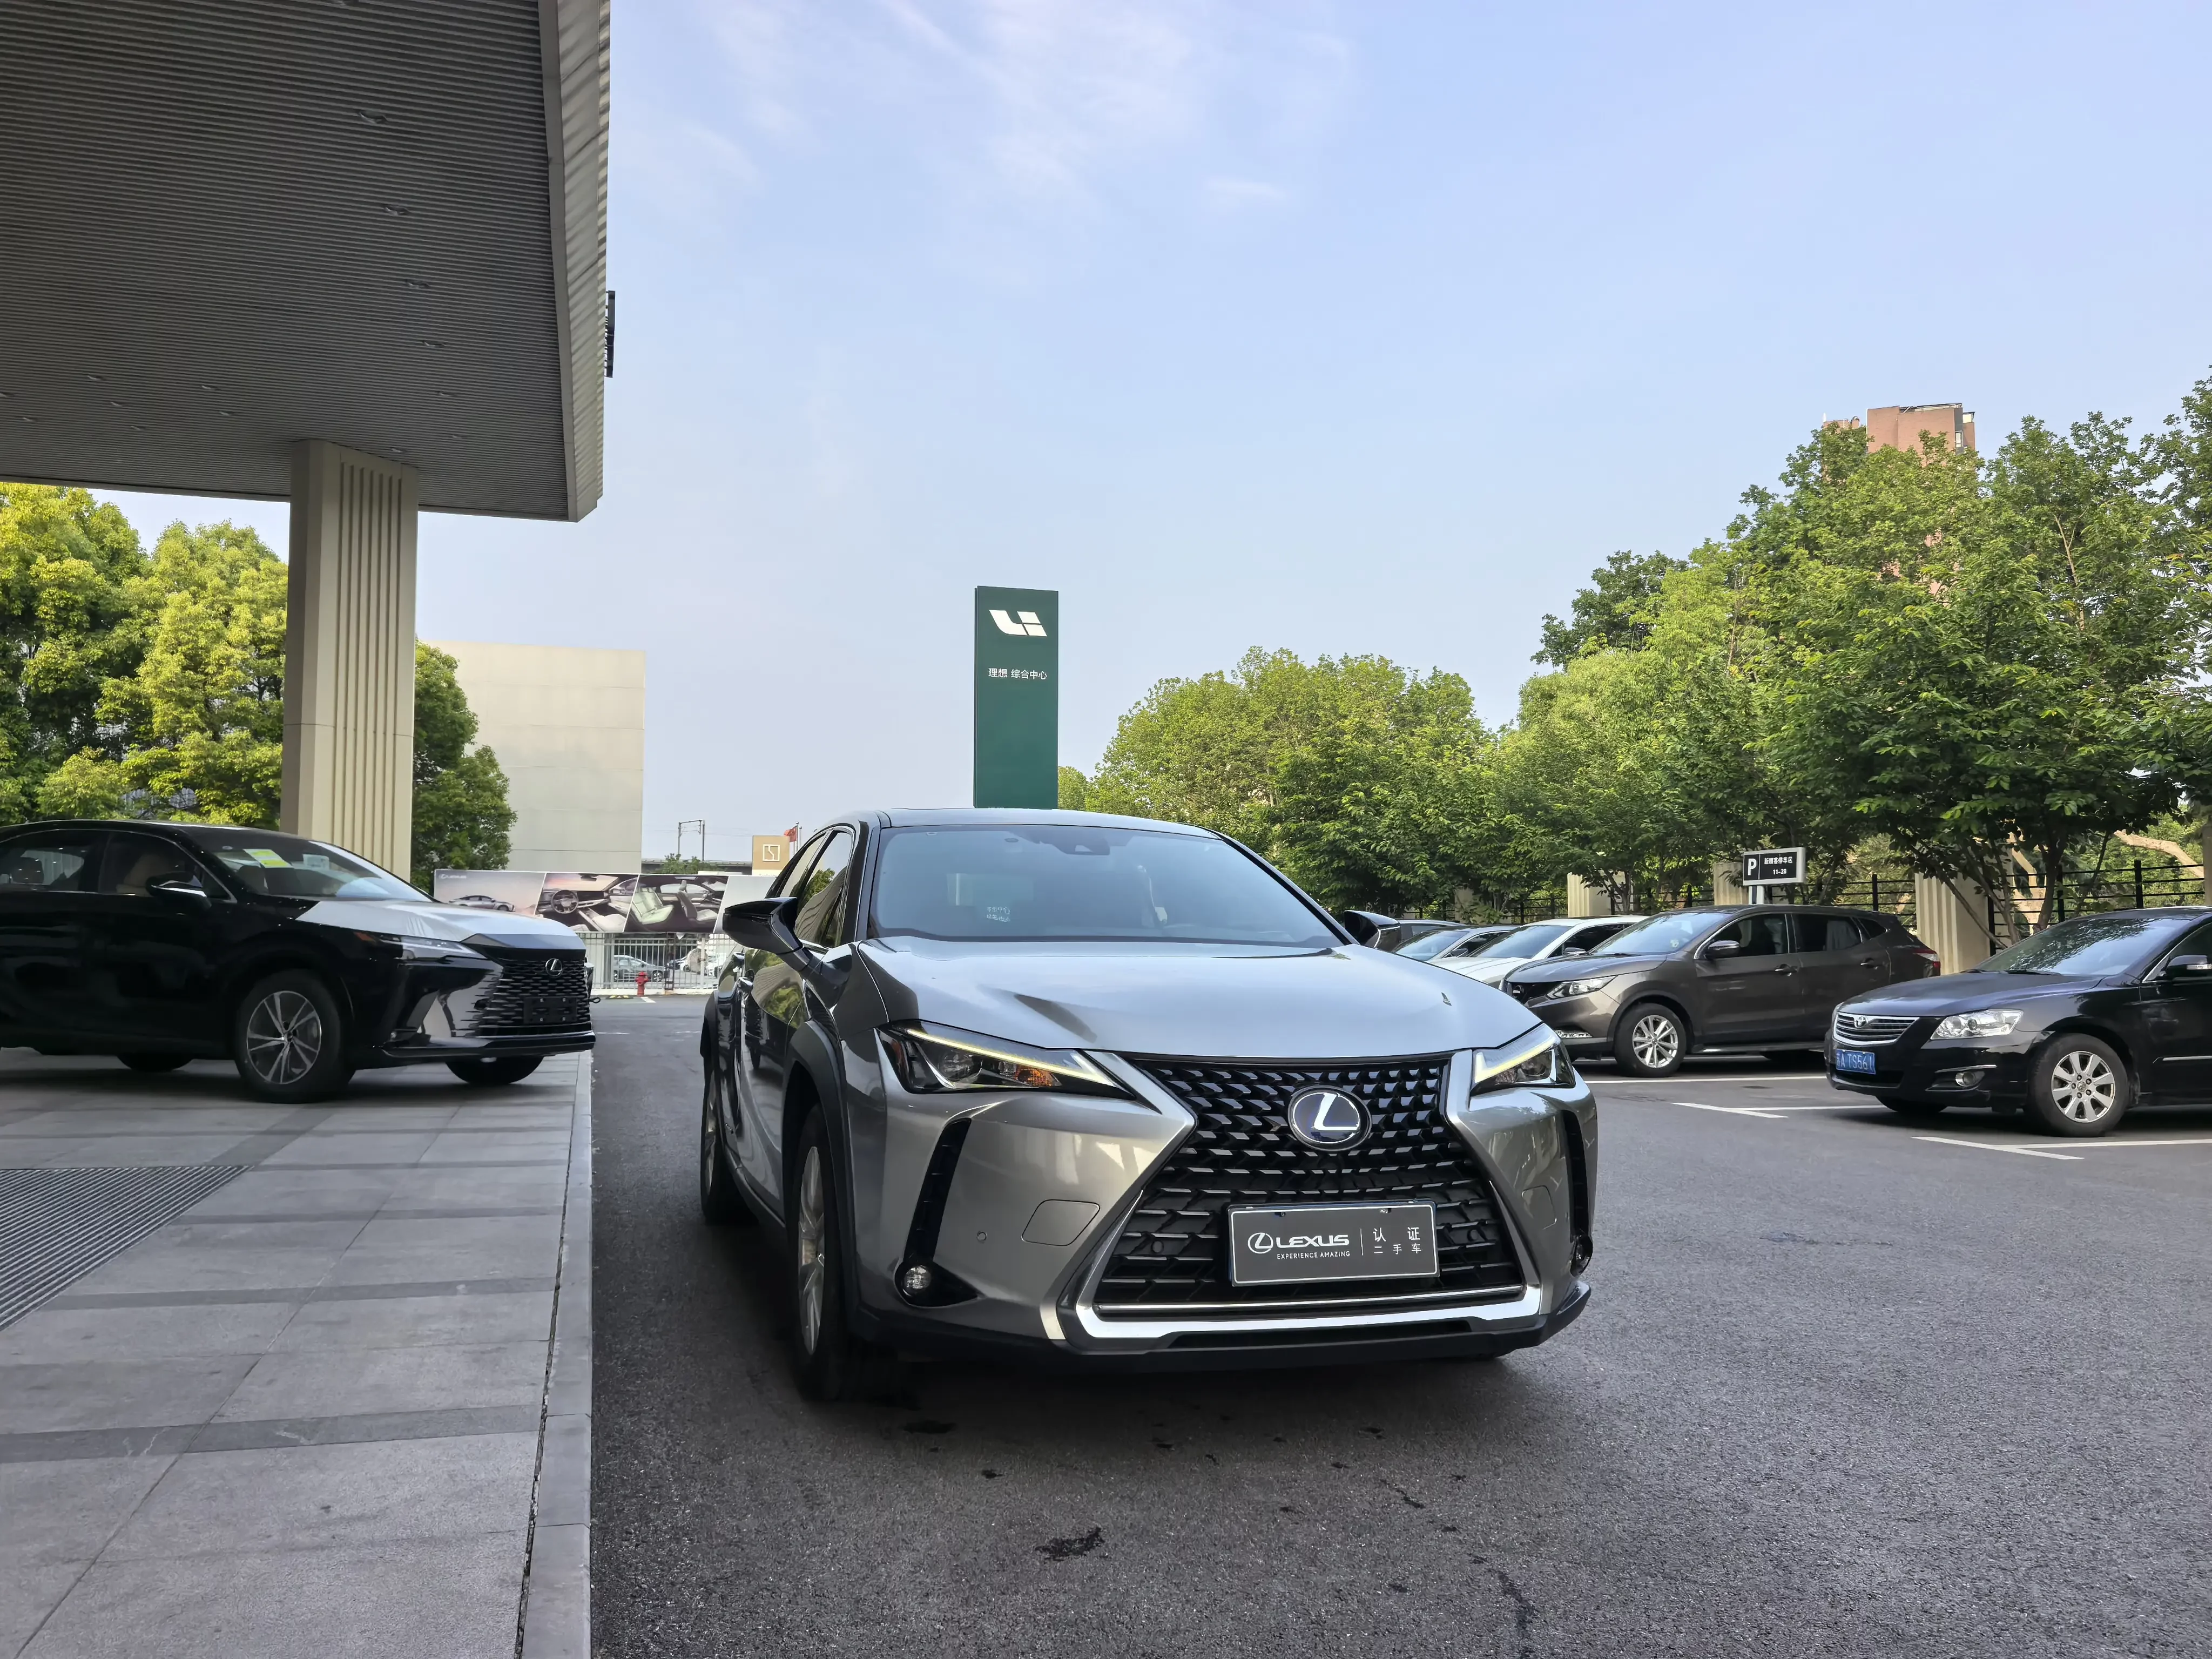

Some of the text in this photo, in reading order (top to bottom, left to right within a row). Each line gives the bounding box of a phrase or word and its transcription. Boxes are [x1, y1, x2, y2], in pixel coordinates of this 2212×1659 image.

[988, 667, 1048, 680] 理想 综合中心
[1748, 858, 1757, 876] P
[1372, 1226, 1421, 1243] 认证
[1276, 1235, 1350, 1249] LEXUS
[1373, 1243, 1422, 1255] 二手车
